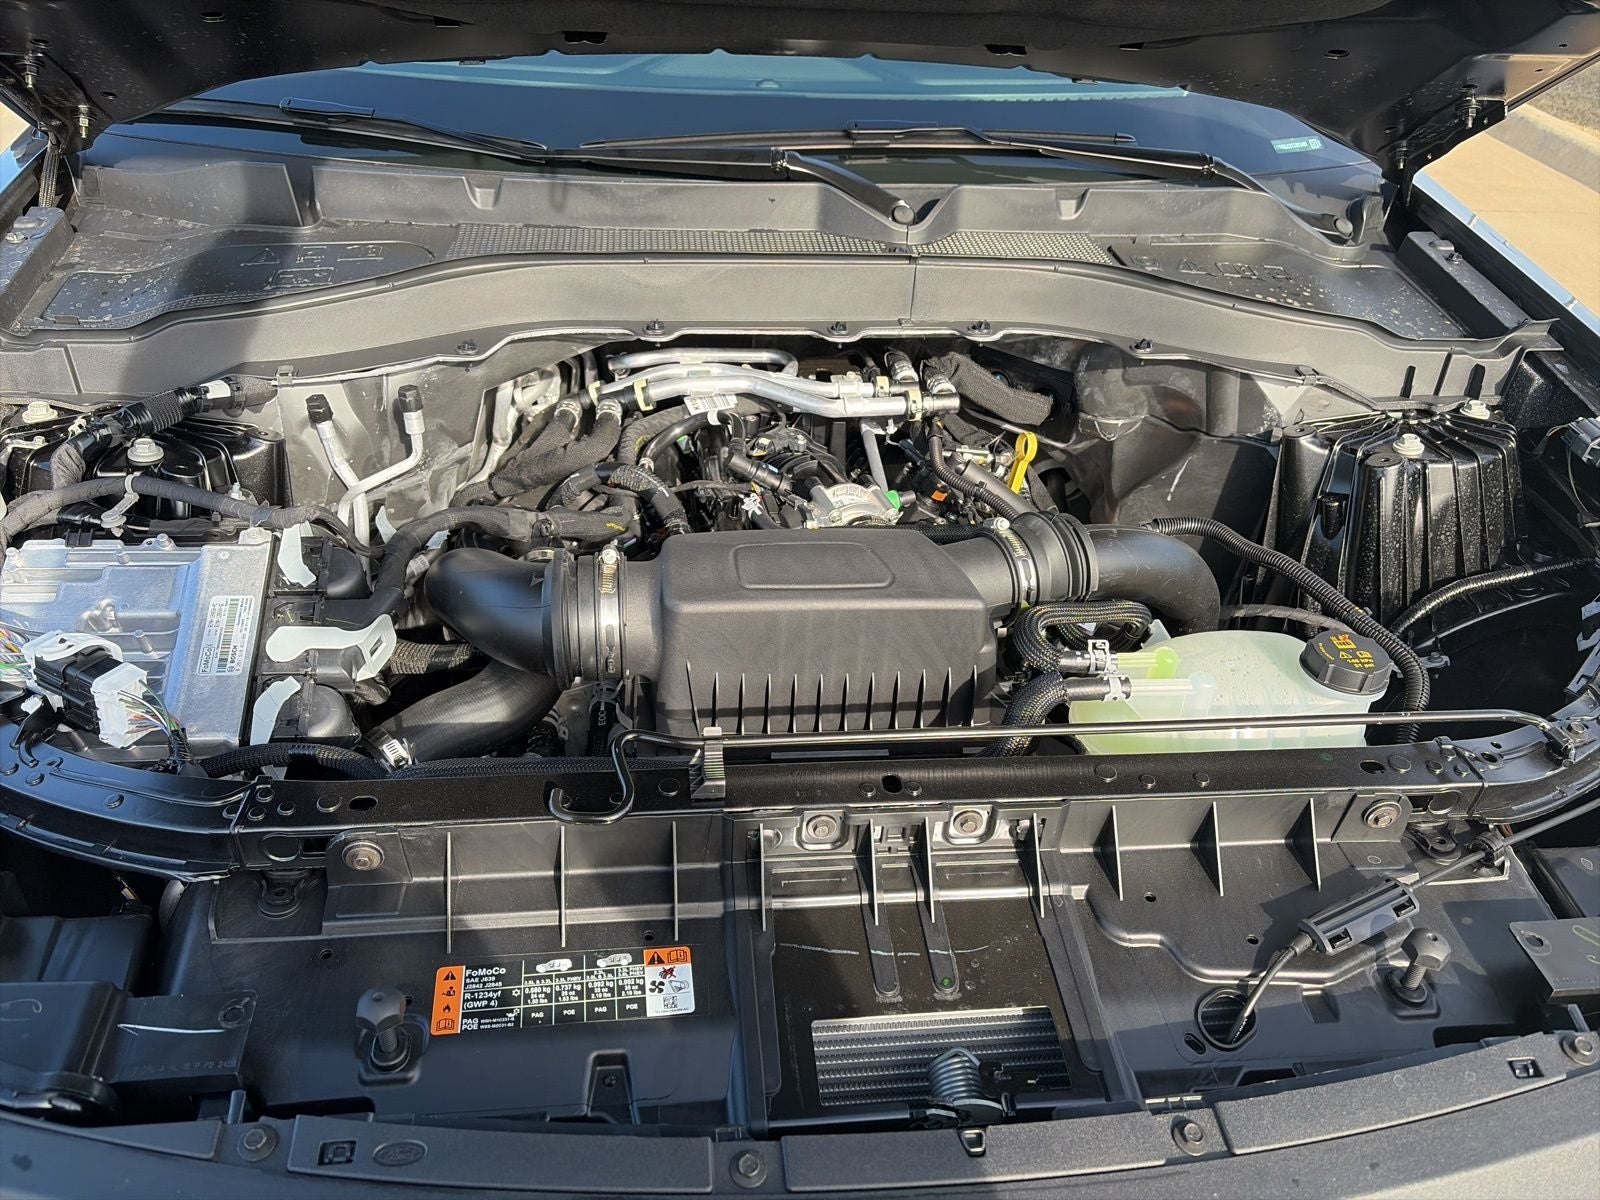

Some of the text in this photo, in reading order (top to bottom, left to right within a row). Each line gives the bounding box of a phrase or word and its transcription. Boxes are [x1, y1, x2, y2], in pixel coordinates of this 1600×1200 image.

[230, 645, 238, 664] BOSCH
[201, 648, 212, 673] FoMoCo
[465, 966, 506, 977] FoMoCo
[465, 990, 501, 1000] R-1234yf
[464, 1000, 488, 1009] (GWP
